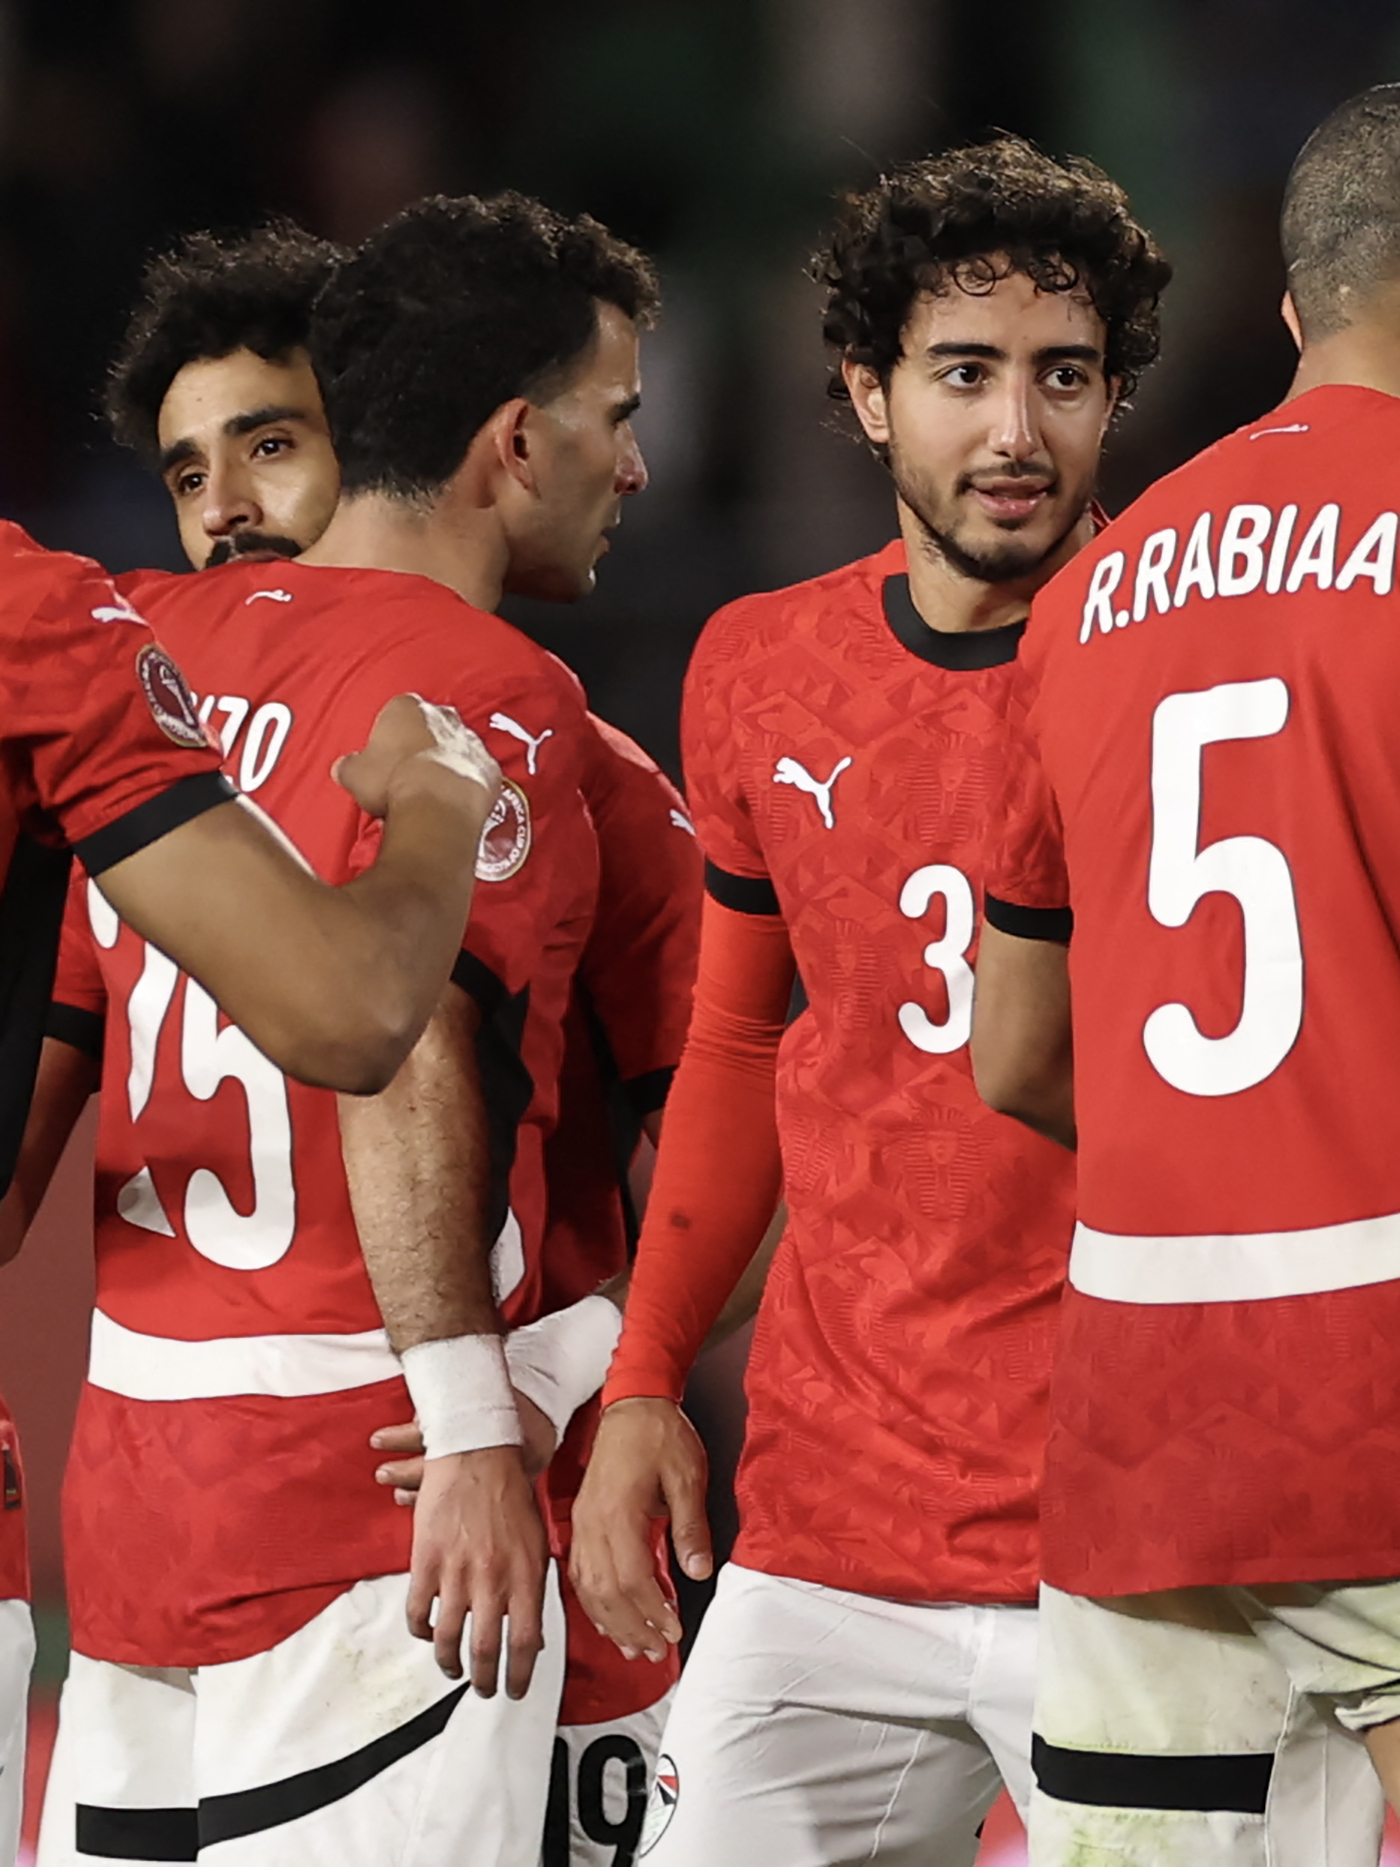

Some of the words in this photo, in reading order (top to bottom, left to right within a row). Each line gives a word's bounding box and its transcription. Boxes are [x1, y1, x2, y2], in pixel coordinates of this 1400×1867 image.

[1079, 503, 1399, 644] R.RABIAA
[898, 864, 975, 1054] 3
[1142, 676, 1305, 1097] 5
